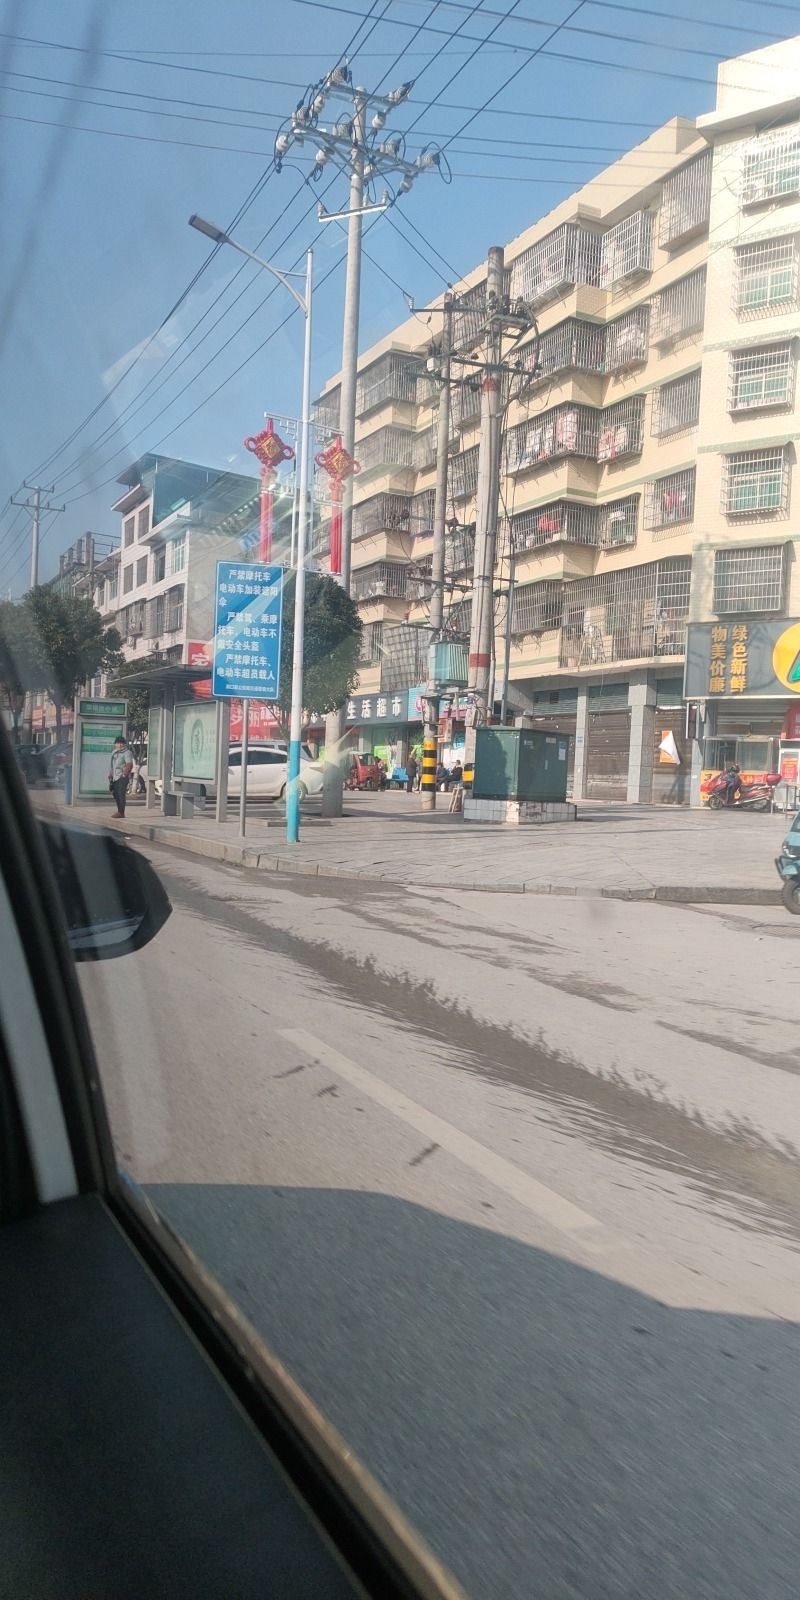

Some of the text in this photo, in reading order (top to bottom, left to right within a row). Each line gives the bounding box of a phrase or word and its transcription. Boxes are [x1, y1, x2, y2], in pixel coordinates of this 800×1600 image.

[229, 569, 271, 582] 严禁摩托车
[709, 625, 728, 693] 物美价廉
[730, 625, 748, 693] 绿色新鲜
[216, 667, 275, 681] 电动车超员载人
[346, 696, 403, 720] 生活超市
